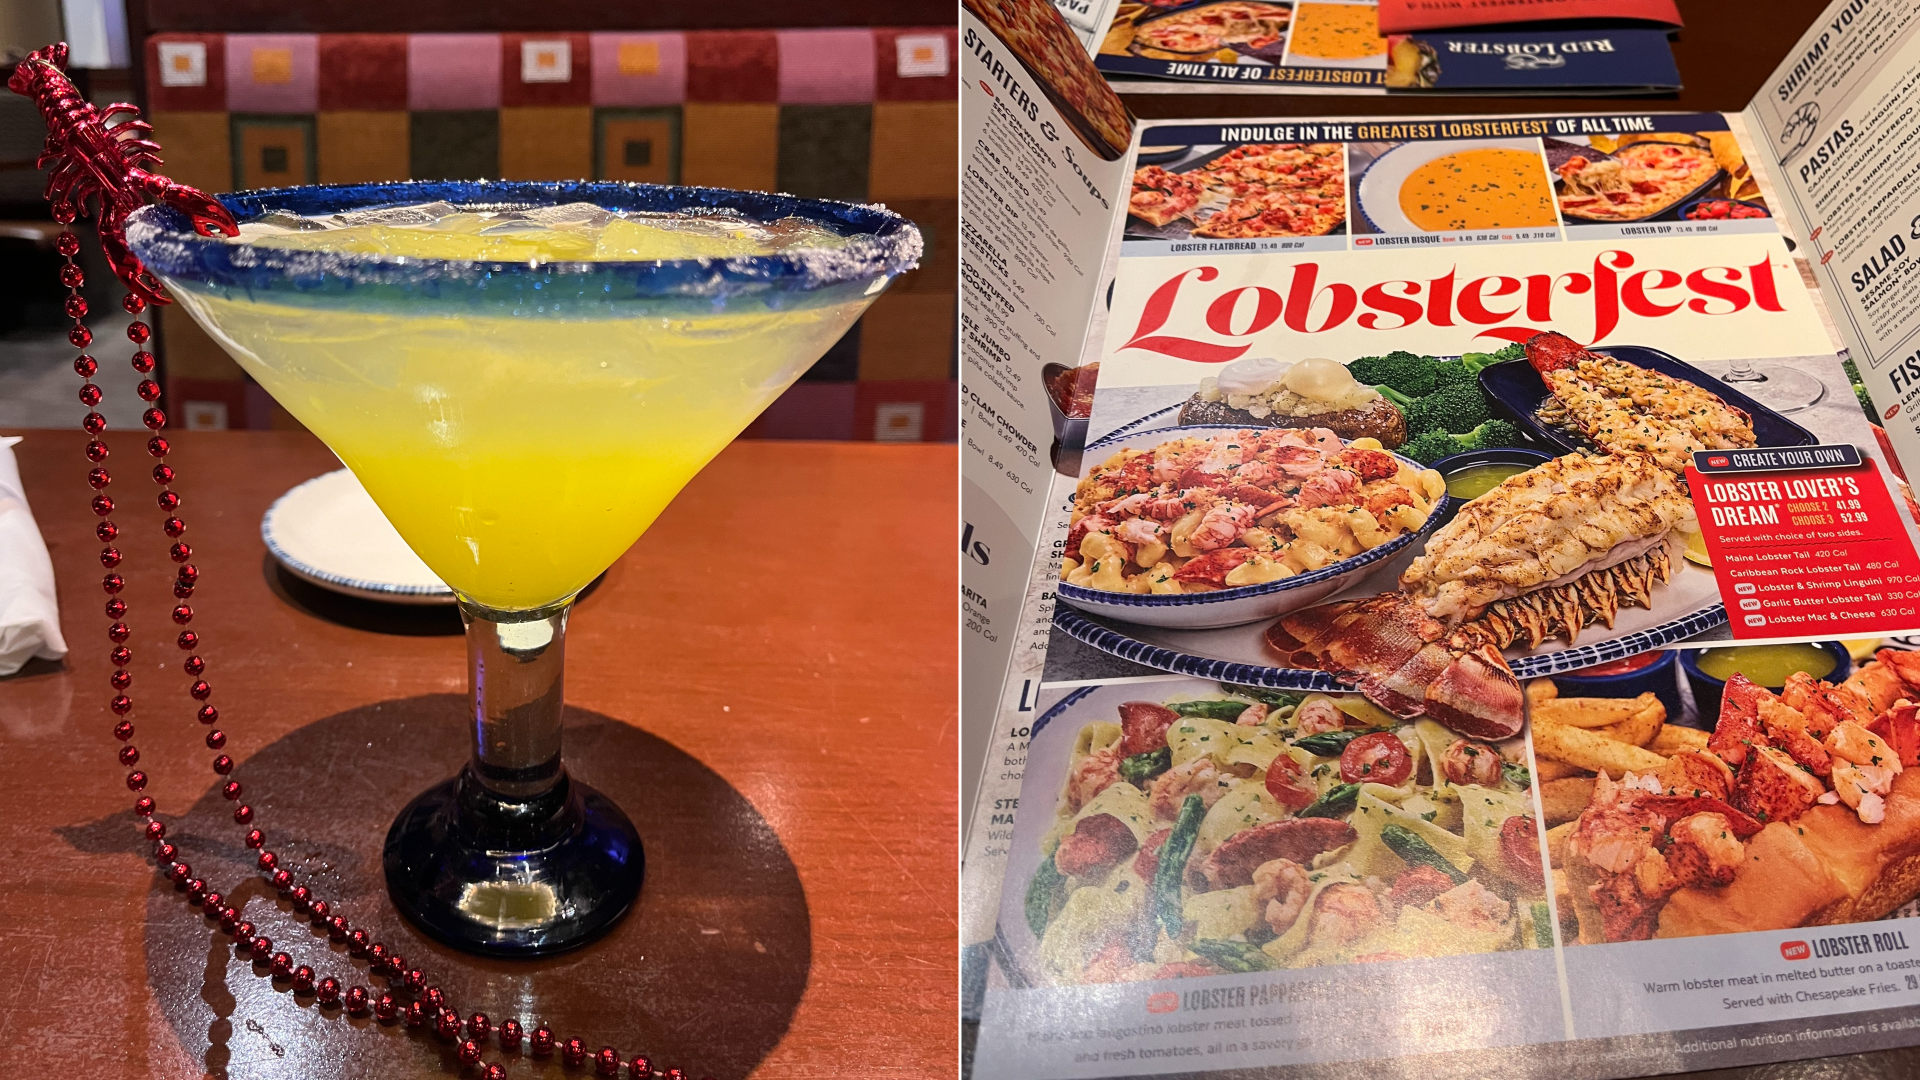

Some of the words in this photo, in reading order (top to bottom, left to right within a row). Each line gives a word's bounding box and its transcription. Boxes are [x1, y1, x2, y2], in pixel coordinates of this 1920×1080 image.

[1449, 41, 1555, 55] LOBSTER
[1561, 39, 1615, 52] RED
[1166, 62, 1205, 76] TIME
[1211, 65, 1239, 78] ALL
[1242, 67, 1262, 80] OF
[1269, 68, 1371, 84] LOBSTERFEST
[1778, 32, 1830, 101] SHRIMP
[964, 28, 1039, 122] STARTERS
[1040, 121, 1059, 142] &
[1062, 146, 1109, 210] Soups
[1221, 127, 1294, 141] INDULGE
[1300, 126, 1313, 140] IN
[1322, 126, 1353, 140] THE
[1358, 124, 1436, 139] GREATEST
[1441, 121, 1550, 137] LOBSTERFEST
[1556, 119, 1576, 133] OF
[1582, 118, 1611, 132] ALL
[1611, 117, 1655, 131] TIME
[993, 102, 1007, 121] SEA
[1009, 121, 1045, 164] SCALLOPS
[995, 97, 1056, 169] BACON-WRAPPED
[1800, 119, 1854, 184] PASTAS
[1807, 167, 1831, 193] CAJUN
[1832, 132, 1864, 167] CHICKEN
[978, 140, 1001, 165] CRAB
[1003, 165, 1029, 196] QUESO
[1815, 181, 1841, 209] SHRIMP
[1842, 144, 1875, 180] LINGUINI
[967, 164, 1004, 205] LOBSTER
[1005, 204, 1019, 219] DIP
[1823, 192, 1854, 226] LOBSTER
[1862, 154, 1891, 185] SHRIMP
[1375, 237, 1410, 245] LOBSTER
[1411, 235, 1440, 244] BISQUE
[1621, 226, 1656, 235] LOBSTER
[1658, 226, 1672, 234] DIP
[1834, 216, 1867, 250] LOBSTER
[1171, 243, 1207, 251] LOBSTER
[1209, 242, 1256, 251] FLATBREAD
[1851, 234, 1906, 293] SALAD
[1861, 256, 1911, 304] SESAME-SOY
[1890, 285, 1918, 309] Brussels
[1875, 306, 1908, 334] edamame,
[969, 332, 1002, 363] SHRIMP
[981, 332, 1011, 361] JUMBO
[970, 393, 996, 418] CLAM
[996, 415, 1037, 454] CHOWDER
[978, 412, 995, 429] Bowl
[997, 429, 1013, 444] 8.49
[1015, 445, 1028, 457] 470
[1028, 455, 1041, 468] Cal
[967, 438, 985, 456] Bowl
[988, 455, 1004, 470] 8.49
[1006, 471, 1020, 484] 630
[1020, 481, 1033, 495] Cal
[1733, 452, 1779, 468] CREATE
[1778, 450, 1814, 465] YOUR
[1814, 449, 1846, 463] OWN
[1704, 480, 1782, 503] LOBSTER
[1783, 477, 1860, 500] LOVER'S
[1787, 502, 1821, 513] CHOOSE
[1822, 502, 1829, 511] 2
[1836, 499, 1861, 511] 41.99
[1791, 515, 1826, 526] CHOOSE
[1828, 514, 1834, 524] 3
[1841, 512, 1869, 523] 52.99
[1719, 535, 1751, 543] Served
[1753, 534, 1773, 542] with
[1775, 532, 1804, 540] choice
[1806, 531, 1816, 539] of
[1837, 528, 1864, 537] sides.
[1725, 554, 1754, 562] Maine
[1756, 553, 1792, 561] Lobster
[1793, 551, 1810, 559] Tail
[1815, 550, 1831, 558] 420
[1832, 549, 1848, 557] Cal
[1730, 568, 1779, 578] Caribbean
[1781, 567, 1805, 575] Rock
[1806, 565, 1842, 573] Lobster
[1843, 563, 1861, 571] Tail
[1866, 562, 1882, 570] 480
[1758, 583, 1794, 592] Lobster
[1797, 582, 1805, 590] &
[1807, 580, 1842, 590] Shrimp
[1843, 577, 1883, 587] Linguini
[1887, 576, 1903, 584] 970
[1763, 598, 1792, 608] Garlic
[1794, 597, 1824, 606] Butter
[1826, 594, 1863, 604] Lobster
[1864, 593, 1883, 602] Tail
[1887, 592, 1904, 600] 330
[962, 602, 991, 625] Orange
[1768, 613, 1805, 624] Lobster
[1807, 613, 1828, 622] Mac
[1830, 612, 1838, 620] &
[1840, 610, 1876, 619] Cheese
[1881, 608, 1897, 617] 630
[1899, 607, 1916, 615] Cal
[966, 618, 982, 633] 200
[983, 629, 998, 643] Cal
[1784, 945, 1806, 957] NEW
[1812, 935, 1872, 959] LOBSTER
[1873, 931, 1909, 952] ROLL
[1643, 982, 1680, 993] Warm
[1683, 978, 1724, 991] lobster
[1728, 975, 1759, 987] meat
[1761, 973, 1773, 983] in
[1776, 968, 1816, 982] melted
[1818, 965, 1855, 978] butter
[1859, 964, 1874, 973] on
[1876, 963, 1884, 972] a
[1183, 986, 1245, 1012] LOBSTER
[1722, 995, 1764, 1010] Served
[1767, 993, 1793, 1005] with
[1795, 986, 1866, 1003] Chesapeake
[1868, 982, 1901, 995] Fries.
[1167, 1021, 1210, 1035] lobster
[1213, 1018, 1247, 1031] meat
[1250, 1014, 1293, 1028] tossed
[1674, 1037, 1737, 1054] Additional
[1740, 1032, 1793, 1047] nutrition
[1795, 1024, 1866, 1041] information
[1868, 1021, 1879, 1033] is
[1104, 1048, 1136, 1061] fresh
[1252, 1039, 1293, 1053] savory
